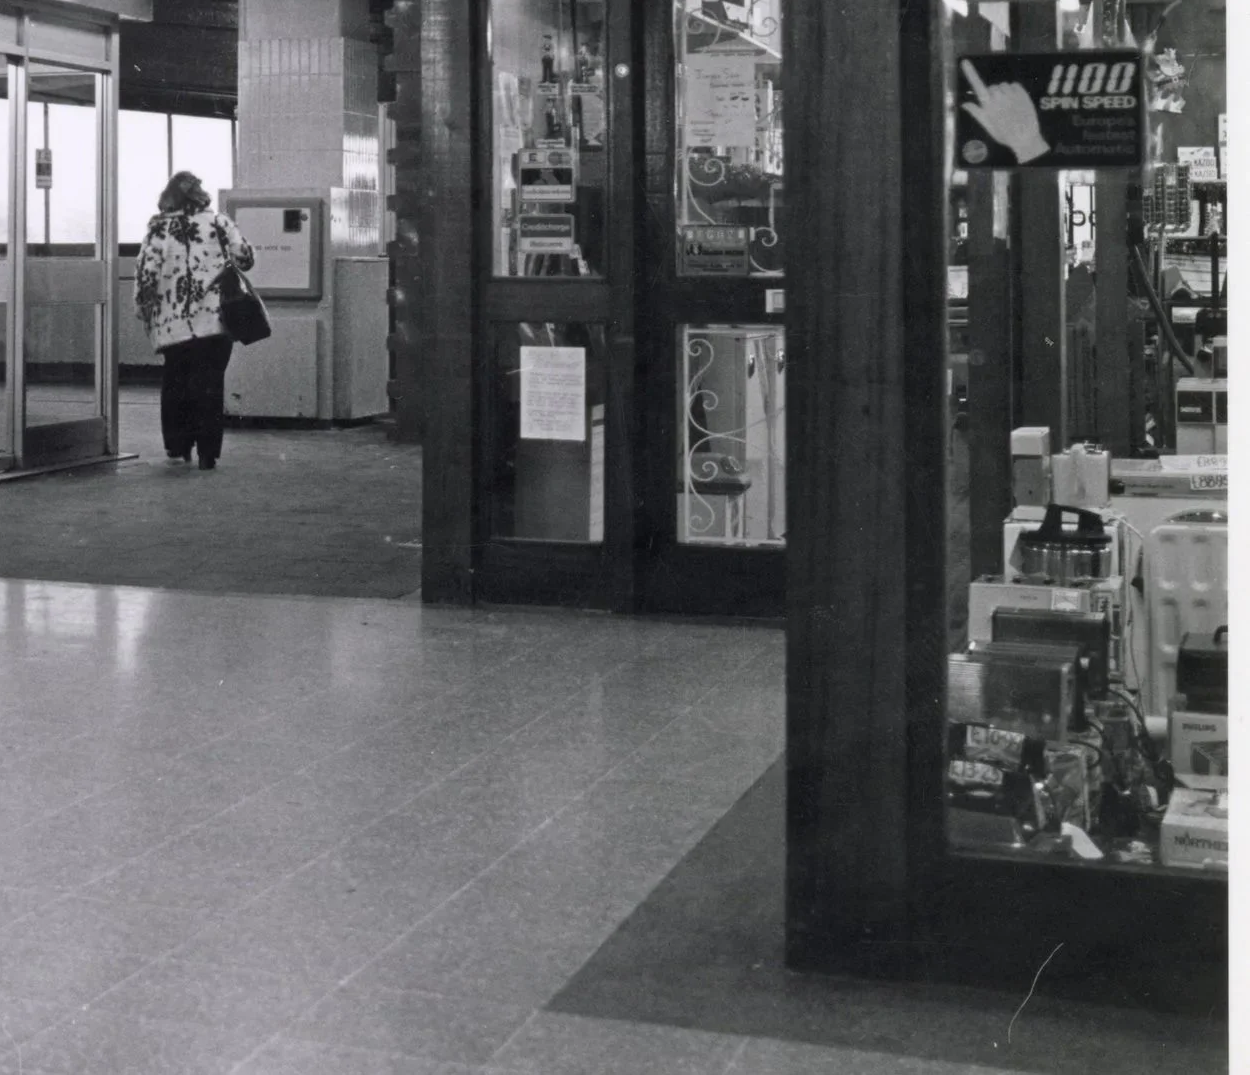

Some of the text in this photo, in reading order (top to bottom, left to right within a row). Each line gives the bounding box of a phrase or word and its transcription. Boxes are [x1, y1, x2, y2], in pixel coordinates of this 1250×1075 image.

[1047, 62, 1136, 94] 1100
[1040, 95, 1137, 110] SPIN SPEED
